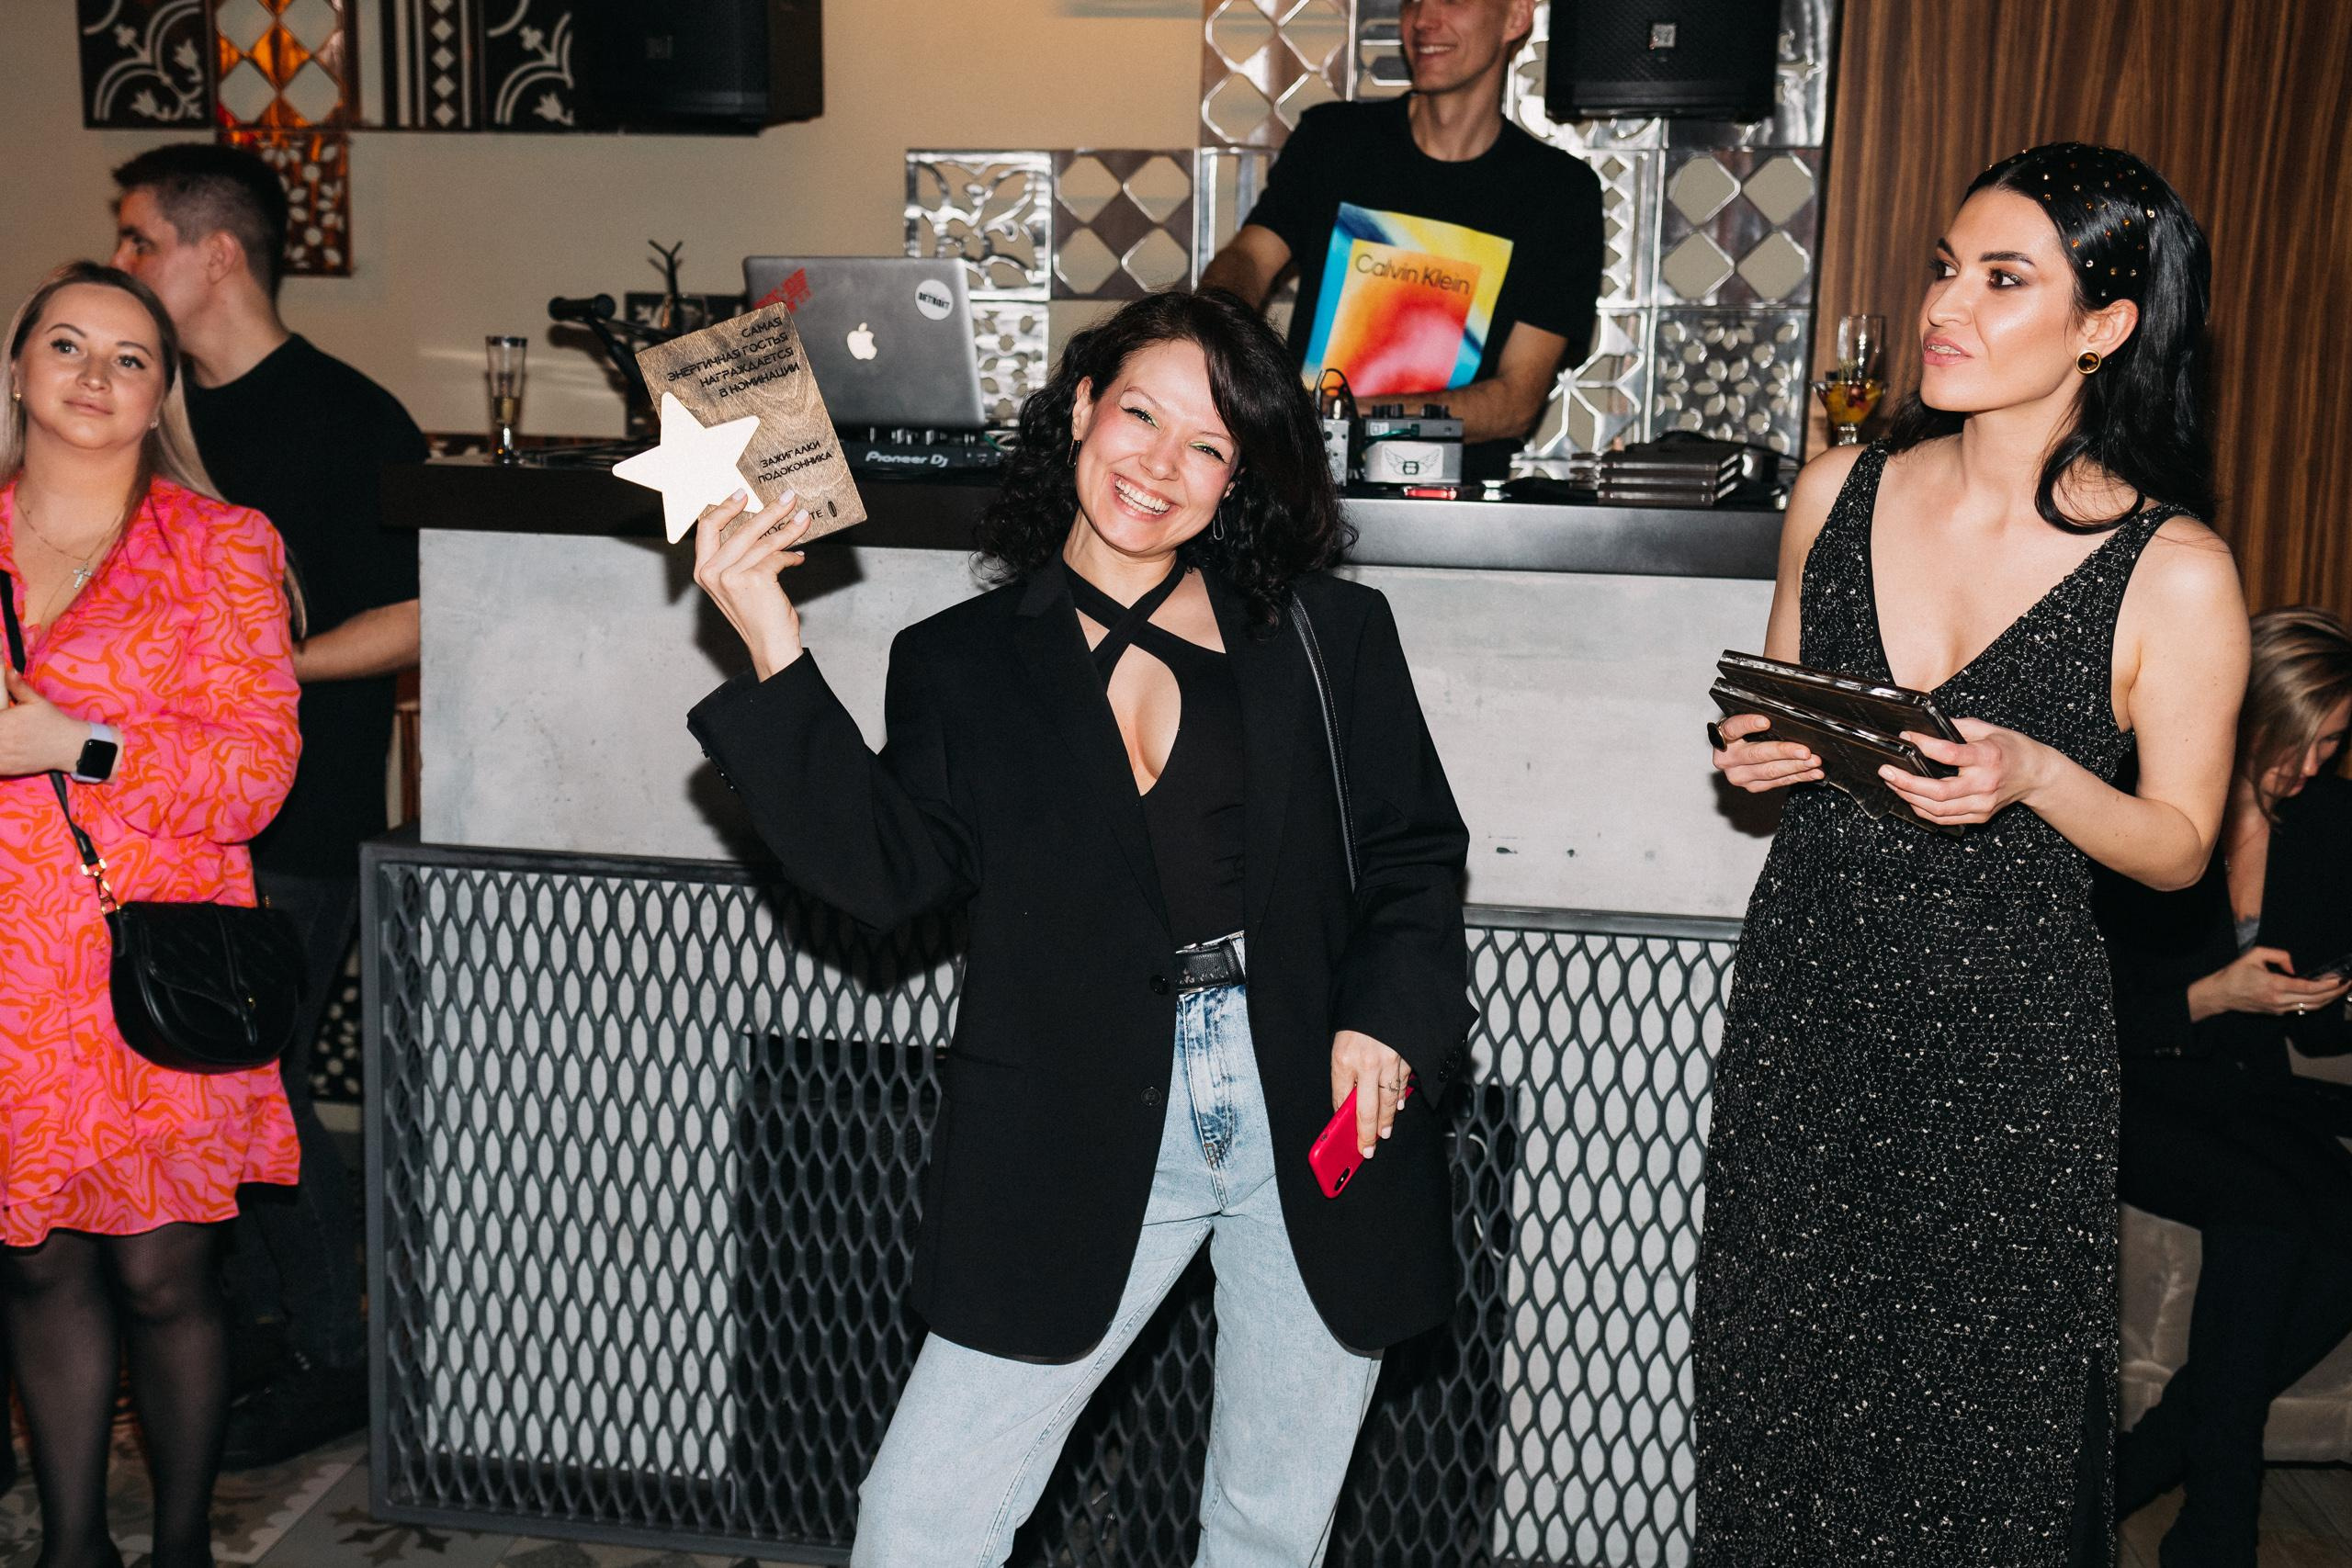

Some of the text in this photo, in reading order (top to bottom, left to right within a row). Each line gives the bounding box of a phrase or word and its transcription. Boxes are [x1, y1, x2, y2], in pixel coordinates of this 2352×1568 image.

[1355, 254, 1470, 295] Calvin Klein
[741, 317, 783, 338] САМАЯ
[667, 332, 789, 382] ЭНЕРГИЧНАЯ ГОСТЬЯ
[699, 347, 795, 388] НАГРАЖДАЕТСЯ
[718, 362, 800, 398] В НОМИНАЦИИ
[758, 451, 833, 484] ПОДОКОННИКА
[761, 441, 821, 468] ЗАЖИГАЛКИ
[865, 450, 928, 464] Pioneer
